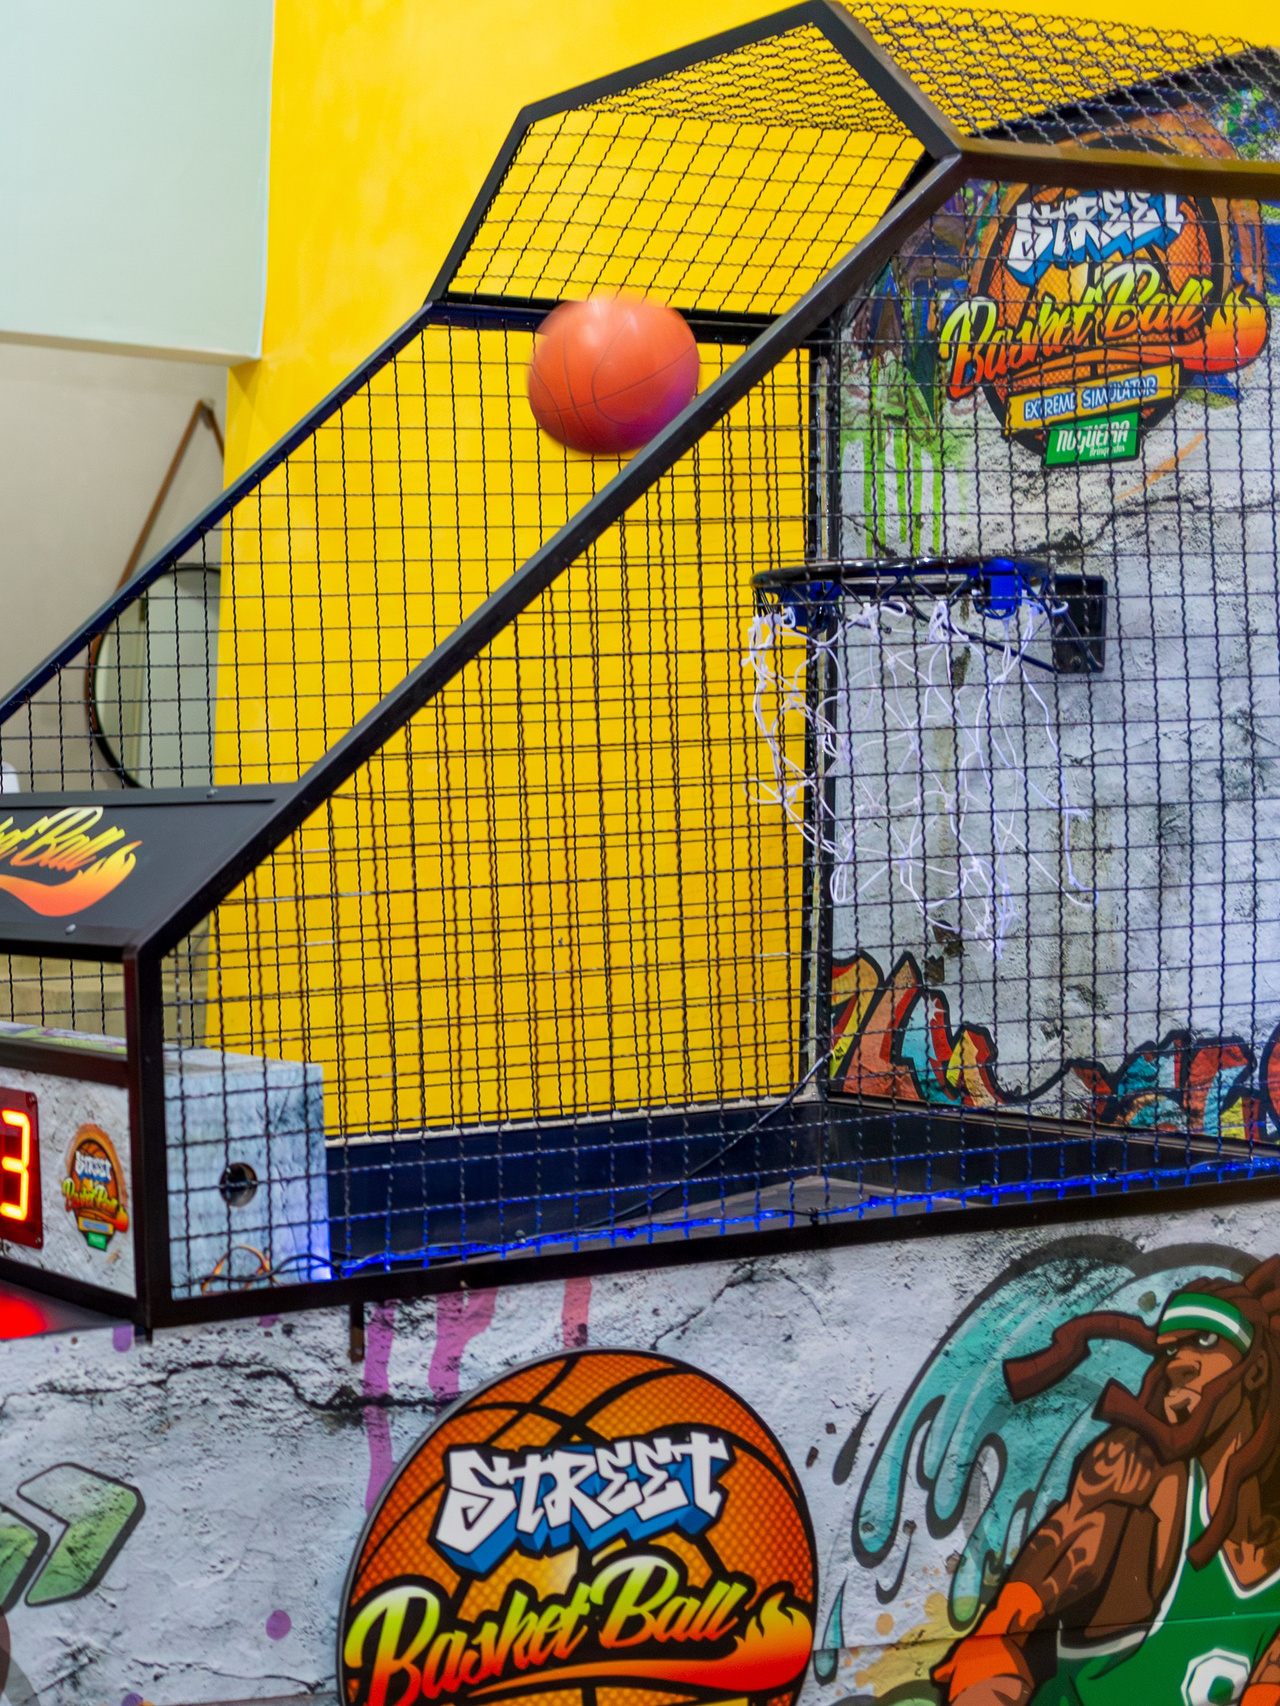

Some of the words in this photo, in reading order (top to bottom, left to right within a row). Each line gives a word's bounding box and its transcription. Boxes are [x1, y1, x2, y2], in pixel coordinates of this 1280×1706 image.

[939, 280, 1104, 399] Basket
[1100, 263, 1213, 339] Ball
[1081, 374, 1159, 410] SIMULATOR
[434, 1431, 730, 1564] STREET
[343, 1584, 592, 1706] Basket
[587, 1554, 748, 1650] Ball
